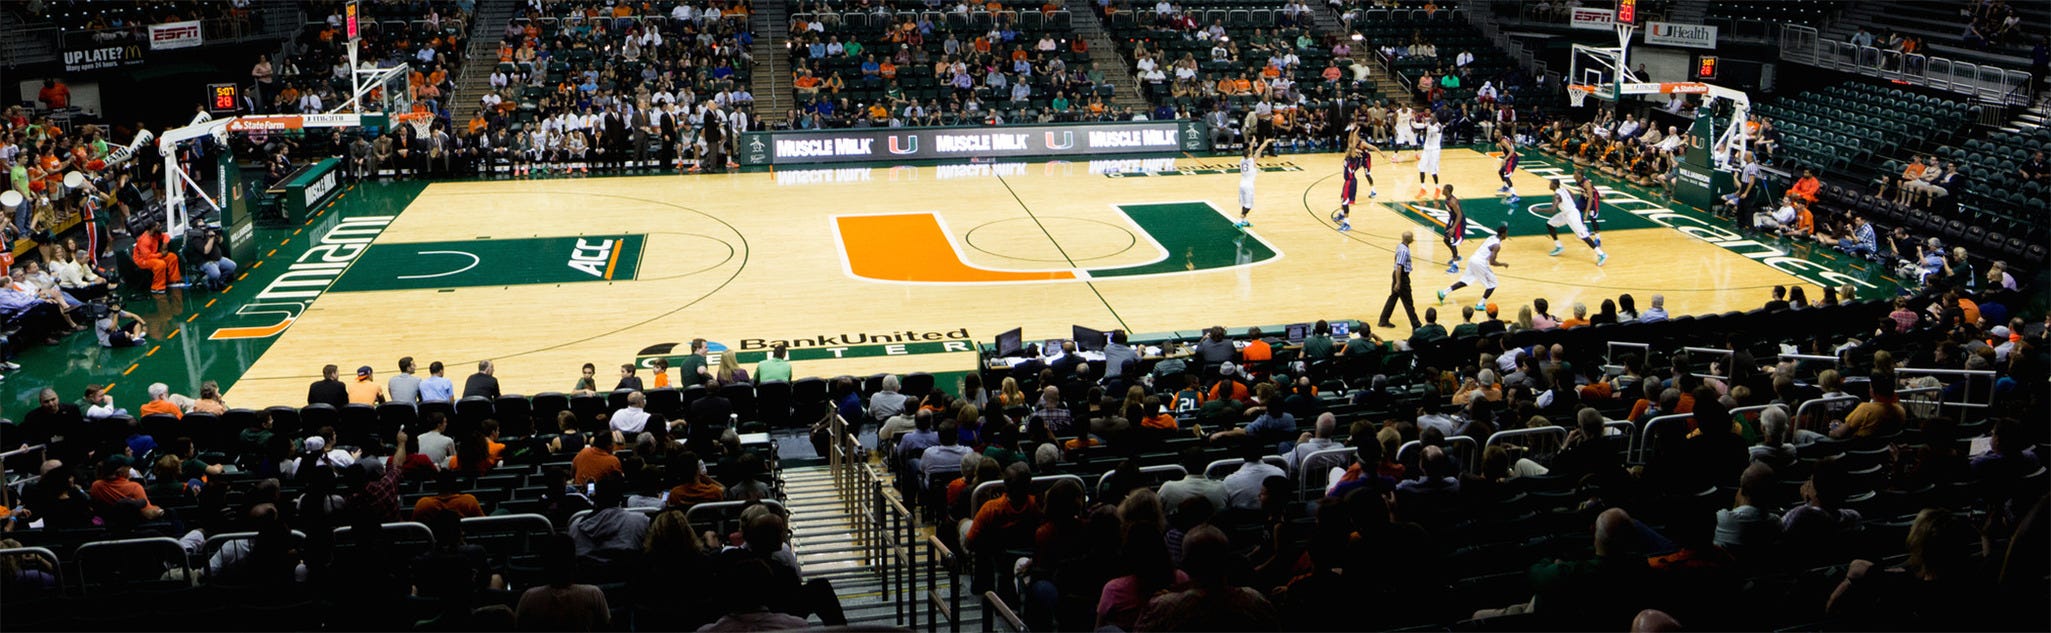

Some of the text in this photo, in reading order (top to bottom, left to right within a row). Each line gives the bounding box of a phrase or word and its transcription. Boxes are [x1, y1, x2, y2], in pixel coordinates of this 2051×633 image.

[1574, 11, 1611, 22] ESPN
[154, 26, 197, 41] ESPN
[64, 47, 123, 64] UP LATE?
[216, 87, 235, 96] 5:07
[216, 96, 233, 108] 28
[936, 133, 1028, 153] MUSCLE MILK
[1089, 130, 1142, 148] MUSCLE
[1143, 128, 1177, 146] MILK
[776, 137, 871, 157] MUSCLE MILK
[567, 237, 614, 278] ACC
[740, 328, 970, 350] BankUnited
[1179, 397, 1195, 413] 21
